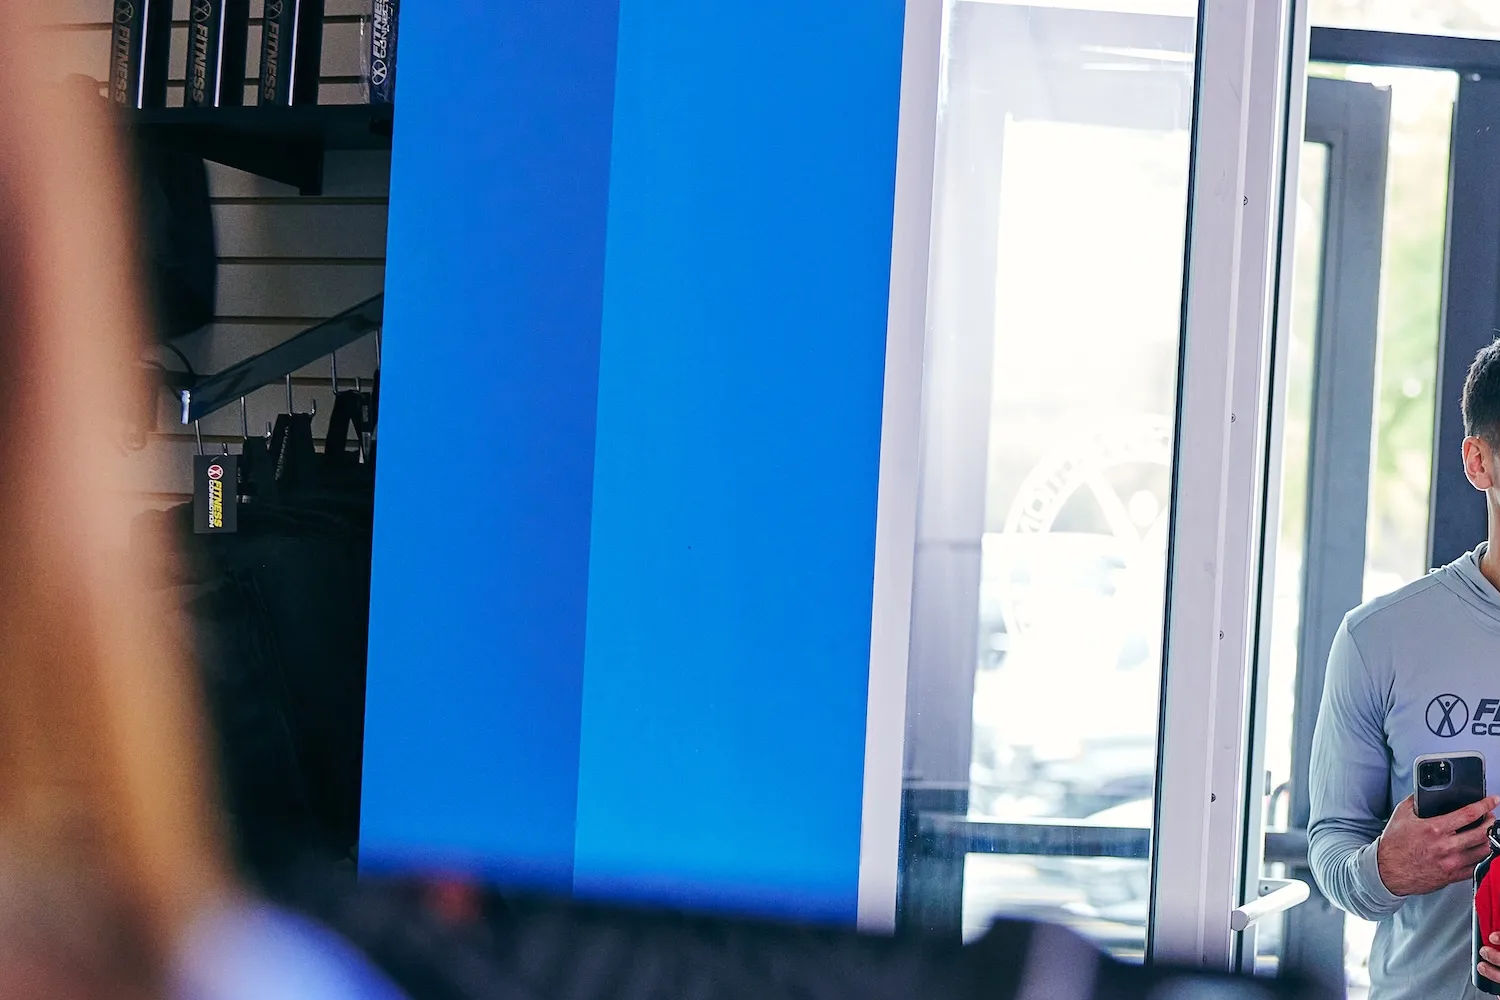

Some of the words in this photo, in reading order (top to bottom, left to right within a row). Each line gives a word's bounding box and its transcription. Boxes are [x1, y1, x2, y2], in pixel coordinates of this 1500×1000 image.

[115, 23, 130, 104] FITNESS
[193, 23, 209, 103] FITNESS
[264, 22, 280, 101] FITNESS
[372, 0, 384, 58] FITNE
[213, 480, 223, 528] FITNESS
